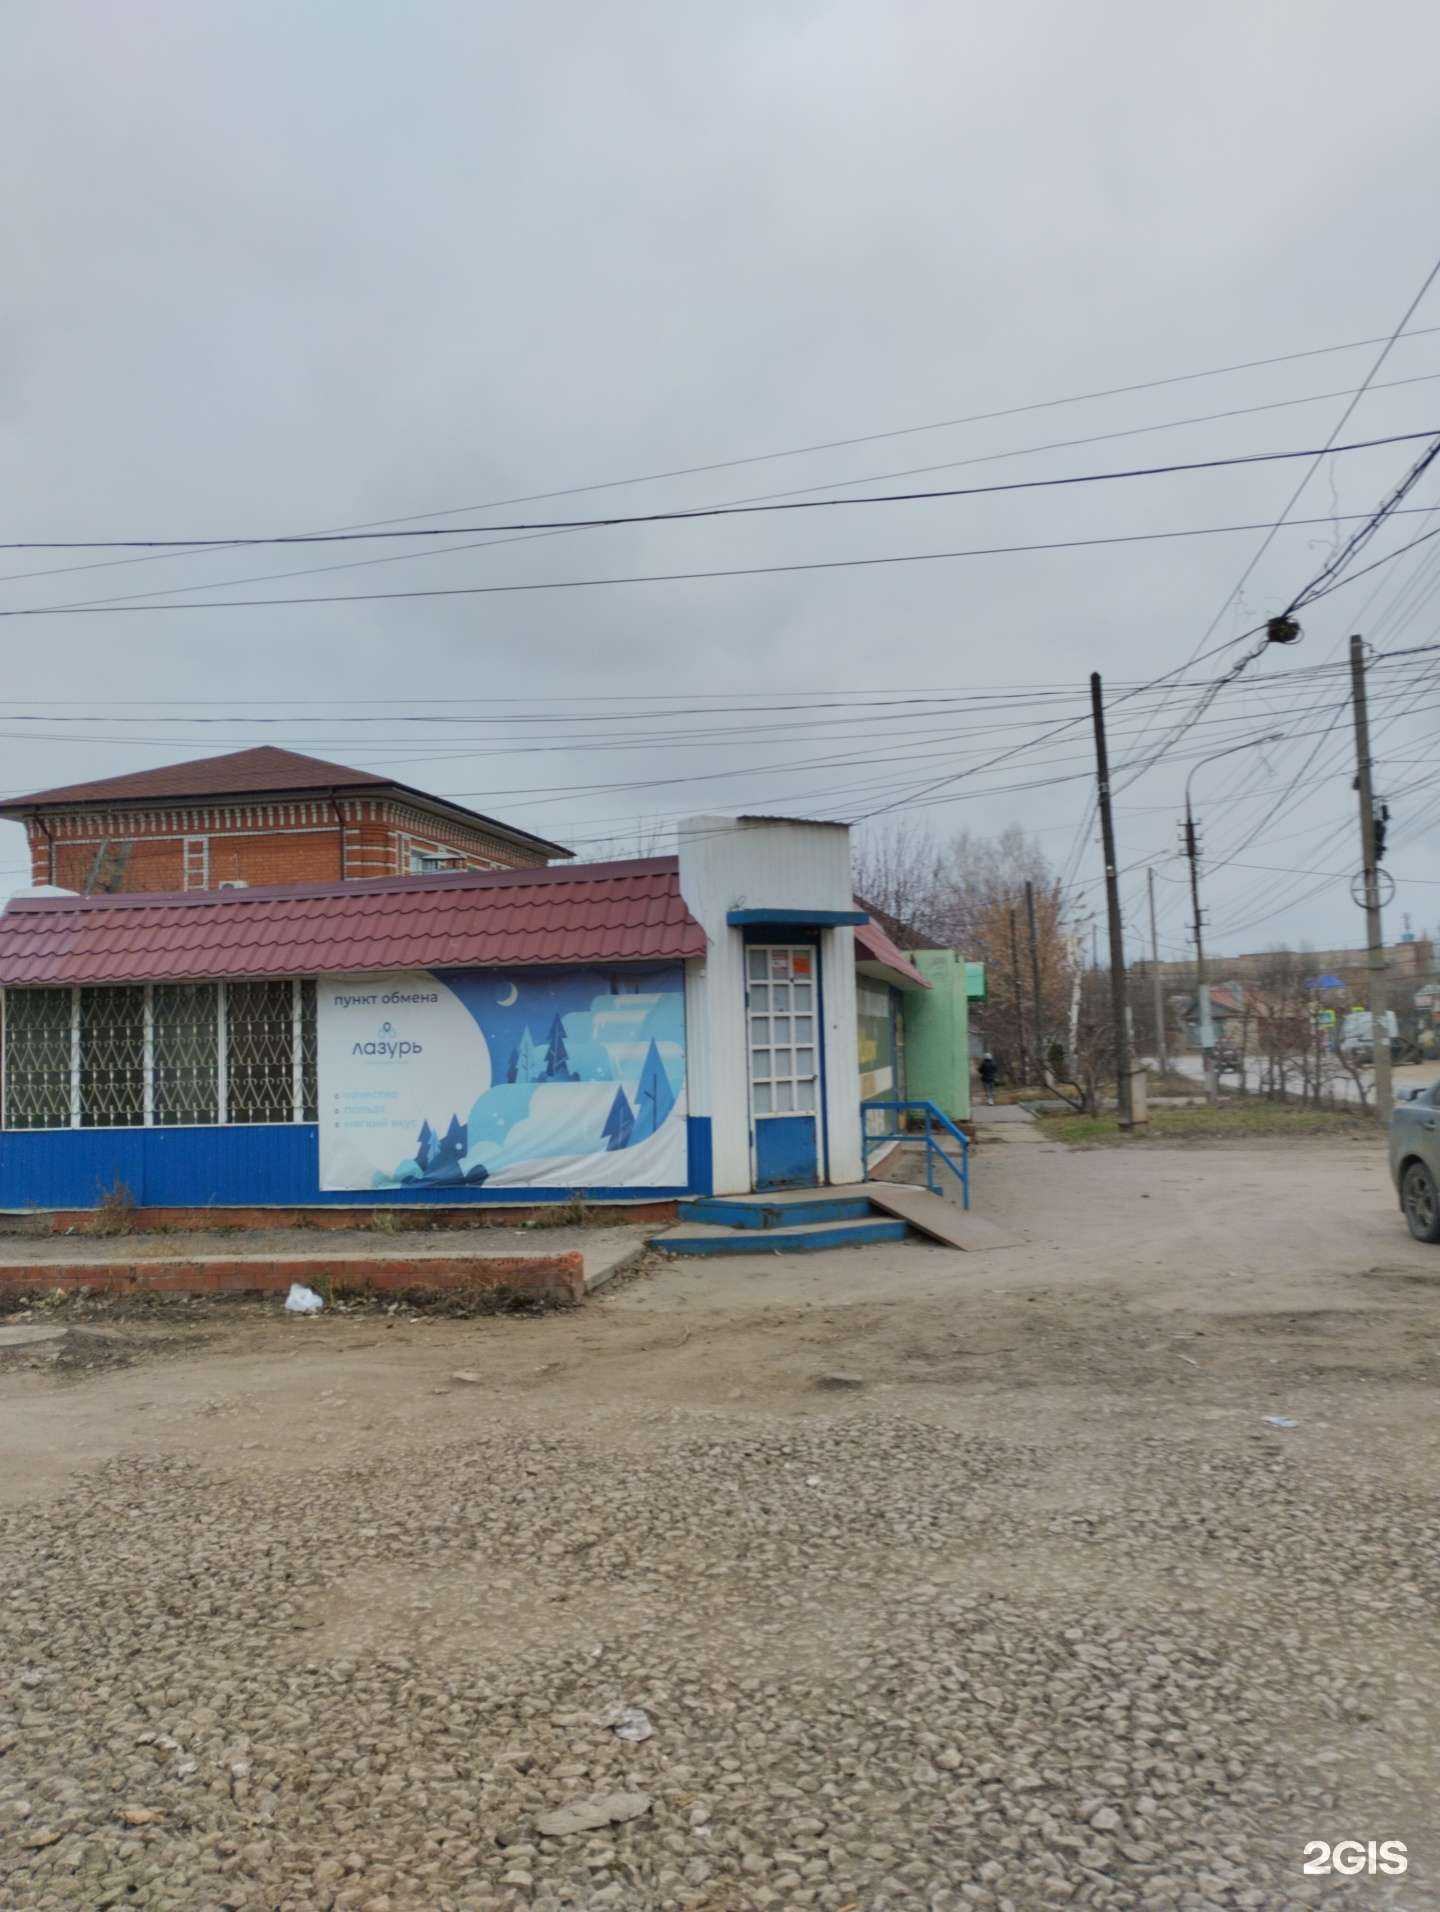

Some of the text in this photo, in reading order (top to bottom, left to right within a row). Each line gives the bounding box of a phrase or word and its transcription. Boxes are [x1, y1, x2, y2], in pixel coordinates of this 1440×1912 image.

[334, 991, 438, 1008] пункт обмена
[352, 1041, 423, 1059] лазурь
